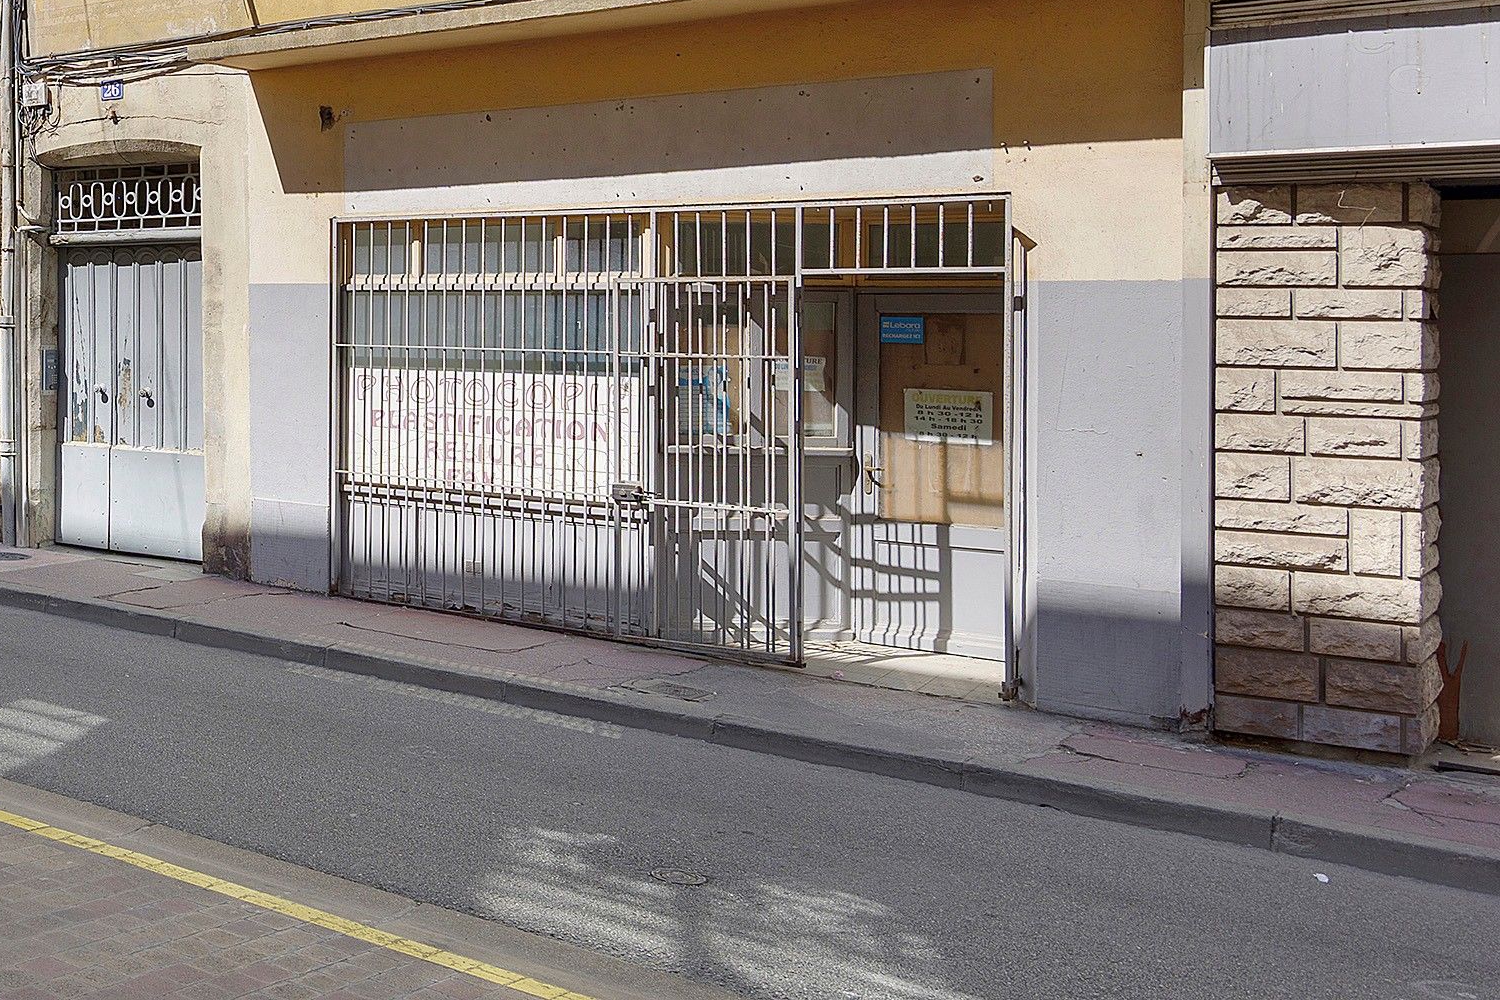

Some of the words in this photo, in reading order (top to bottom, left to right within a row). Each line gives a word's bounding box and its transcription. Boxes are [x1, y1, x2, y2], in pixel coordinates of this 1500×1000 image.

[103, 83, 120, 97] 26
[890, 321, 921, 329] Lebara
[371, 409, 608, 442] PLASTIFICATION
[931, 423, 967, 431] Samedi
